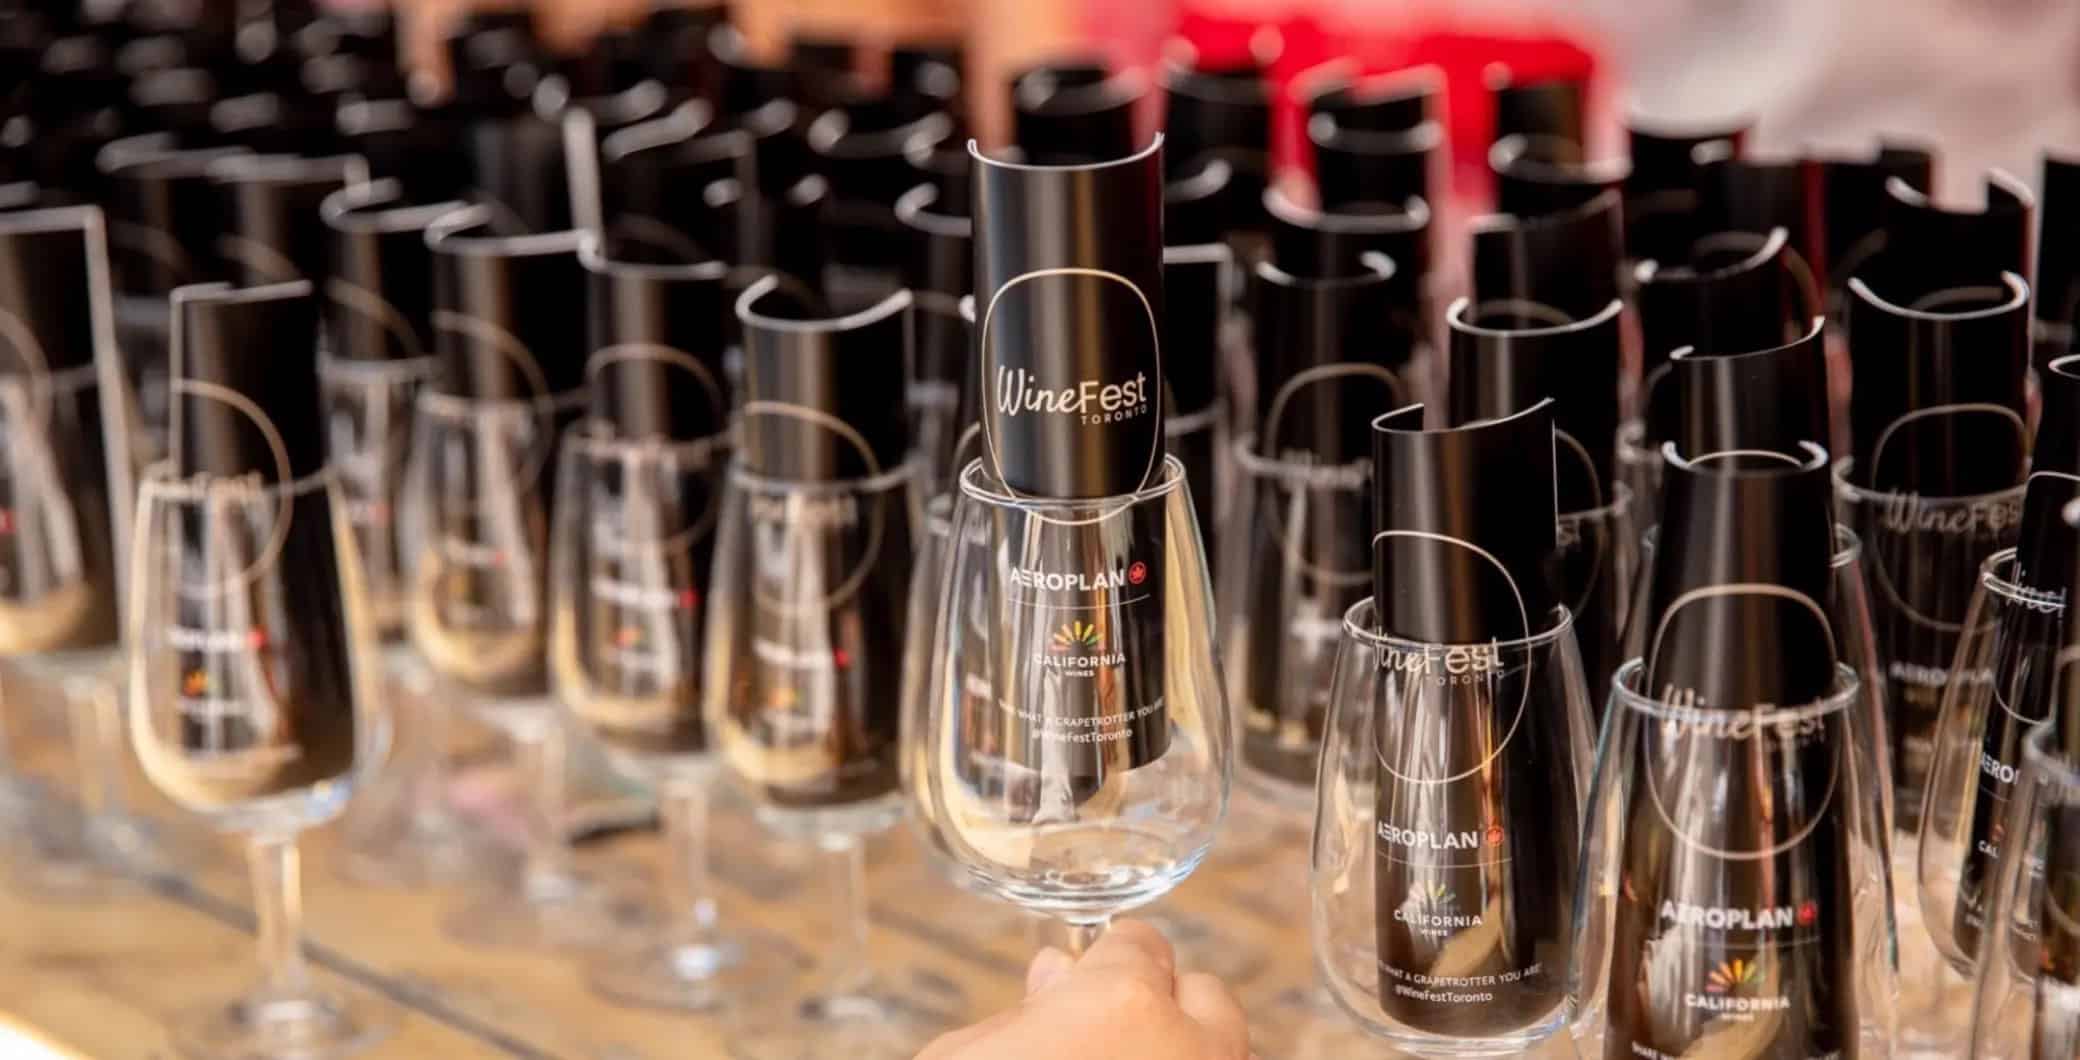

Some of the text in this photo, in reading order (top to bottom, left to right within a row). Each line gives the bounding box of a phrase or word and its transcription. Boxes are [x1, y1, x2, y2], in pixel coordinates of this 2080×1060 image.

[997, 364, 1147, 417] WineFest
[1081, 404, 1148, 425] TORONTO
[1888, 488, 2020, 533] WineFes
[1009, 566, 1125, 592] AEROPLAN
[1033, 652, 1127, 668] CALIFORNIA
[1377, 820, 1479, 849] AEROPLAN
[1394, 909, 1483, 927] CALIFORNIA
[1660, 900, 1793, 929] AEROPLAN
[1413, 974, 1496, 988] GRAPETROTTER
[1498, 970, 1521, 985] YOU
